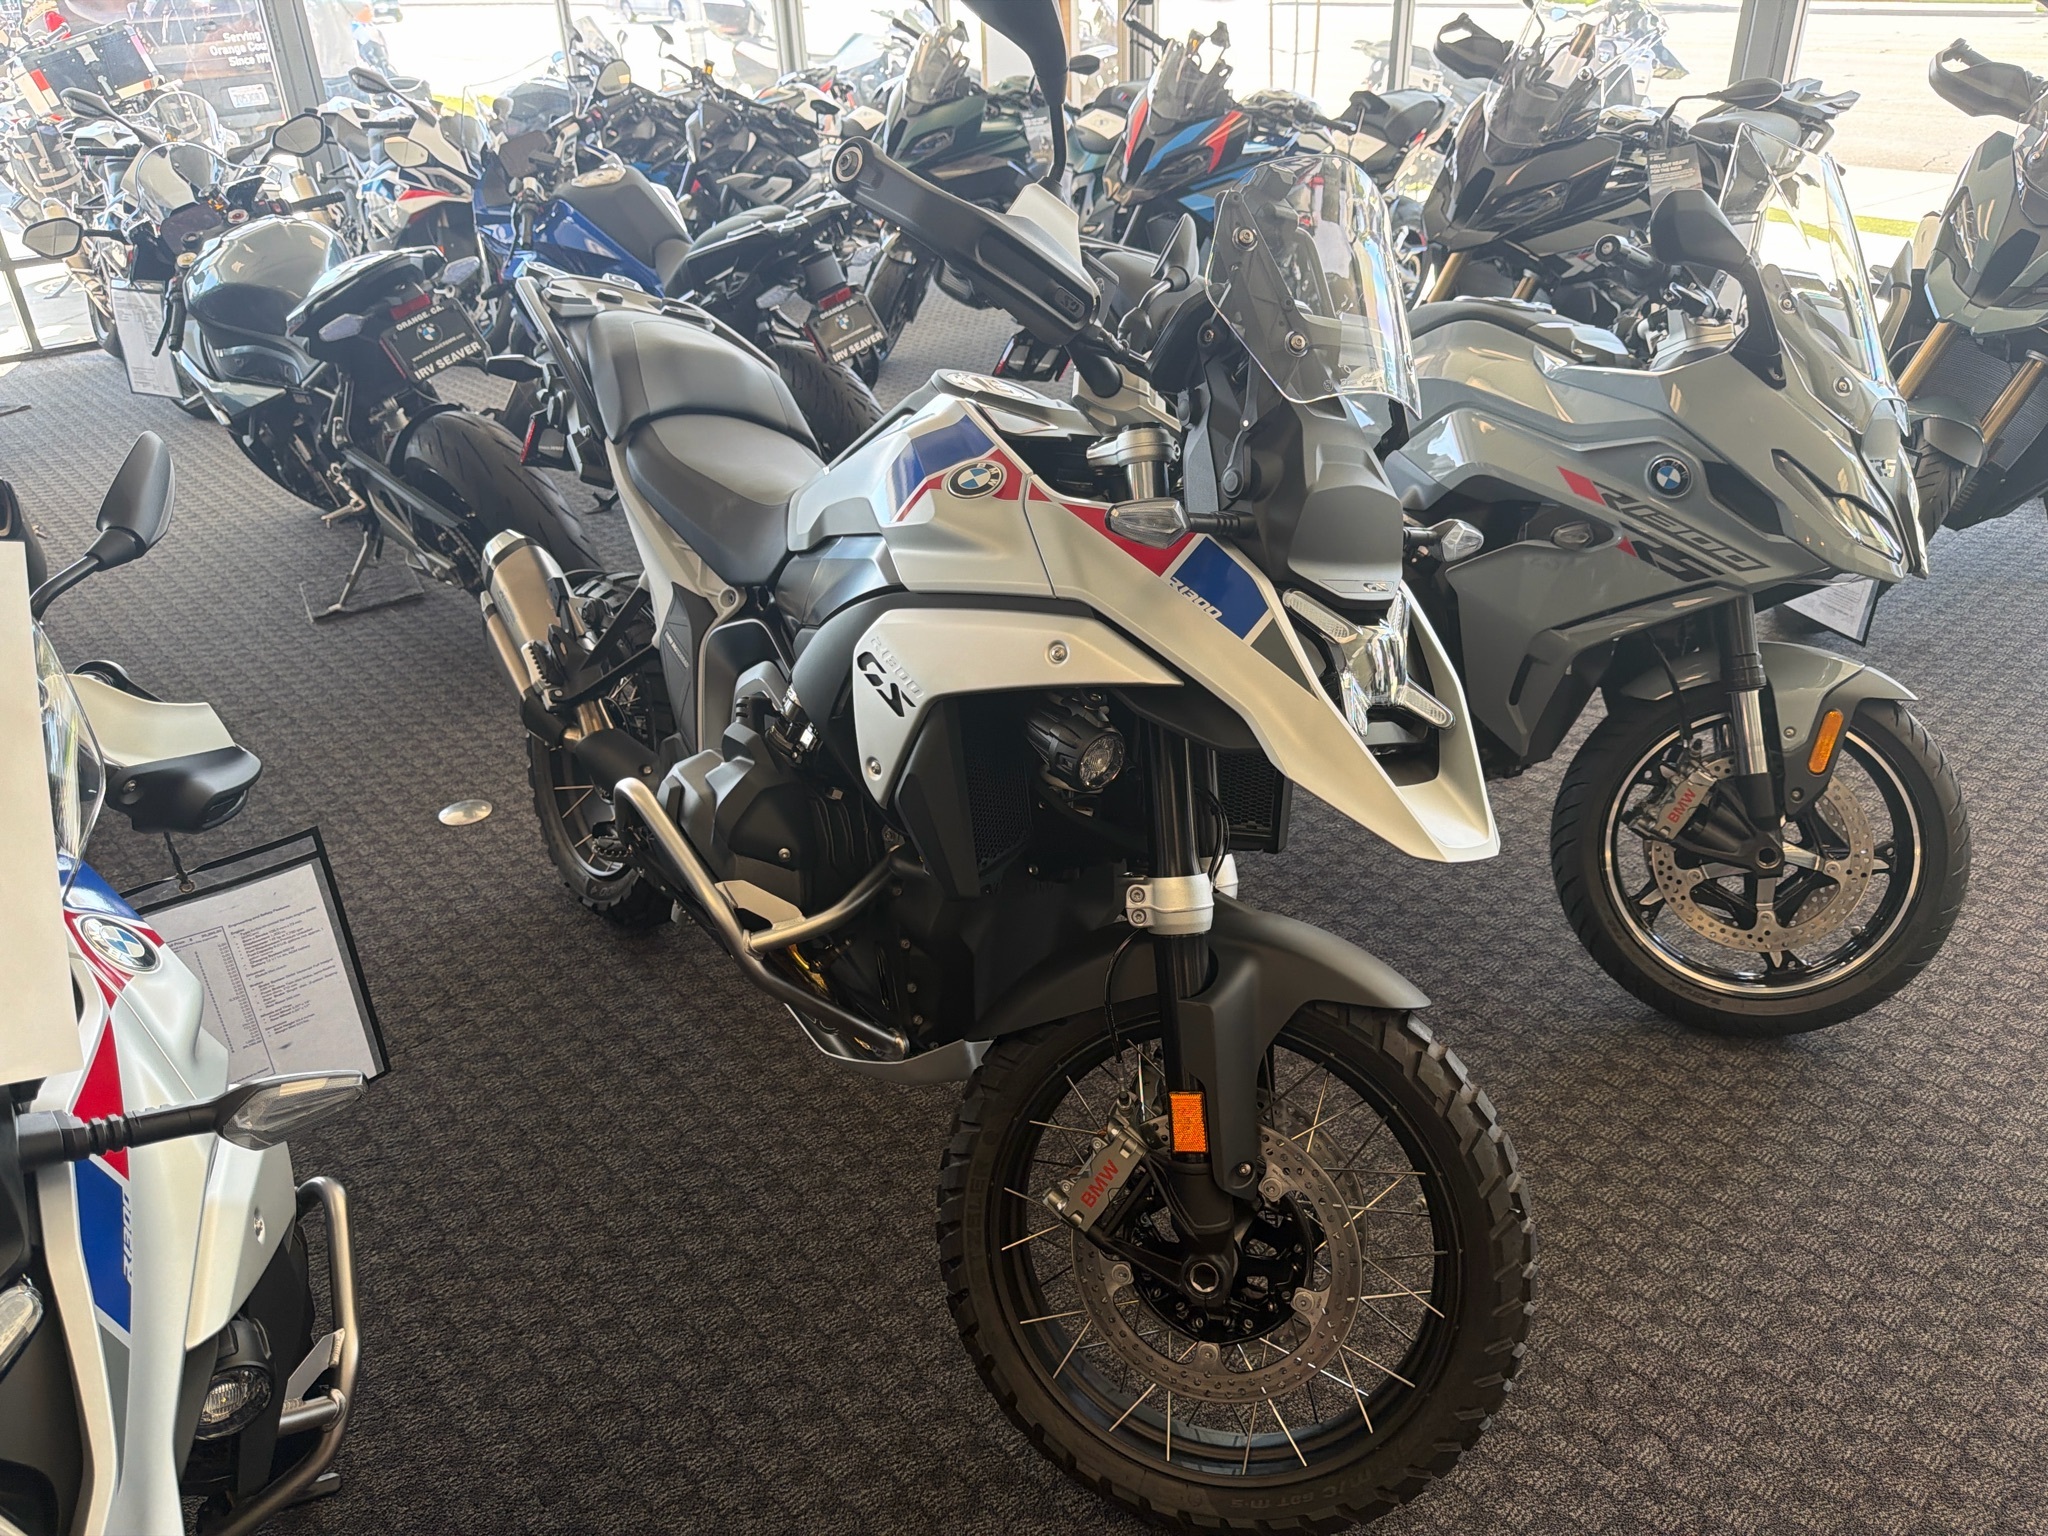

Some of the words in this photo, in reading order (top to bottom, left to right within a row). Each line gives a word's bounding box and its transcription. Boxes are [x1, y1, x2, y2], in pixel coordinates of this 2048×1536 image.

[209, 45, 247, 56] Orange
[222, 30, 262, 44] Serving
[228, 56, 255, 67] Since
[414, 363, 436, 380] IRV
[435, 340, 482, 369] SEAVER
[831, 347, 849, 363] IRV
[848, 331, 884, 355] SEAVER
[1618, 519, 1726, 583] RS
[1168, 576, 1224, 621] R1300
[856, 651, 917, 718] GS
[870, 636, 925, 700] R1300
[1667, 787, 1697, 824] BMW
[1081, 1158, 1119, 1208] BMW
